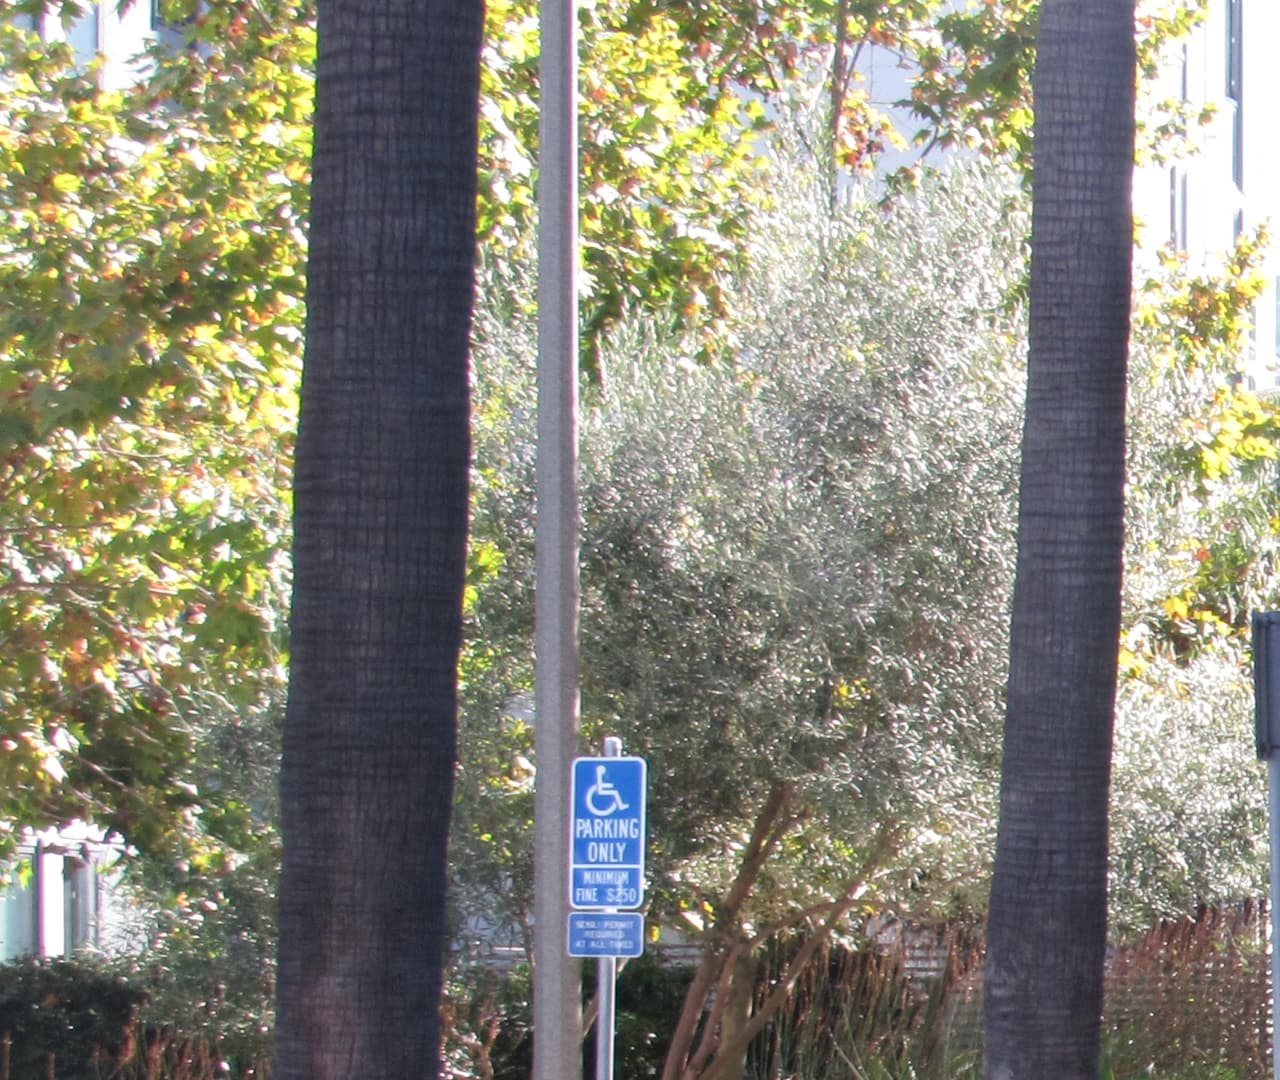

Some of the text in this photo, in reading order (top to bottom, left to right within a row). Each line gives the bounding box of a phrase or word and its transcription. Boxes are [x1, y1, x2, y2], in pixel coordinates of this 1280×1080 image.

[575, 818, 639, 838] PARKING
[587, 842, 627, 862] ONLY
[583, 871, 629, 885] MINIMUM
[575, 888, 598, 902] FINE
[606, 887, 637, 903] $250
